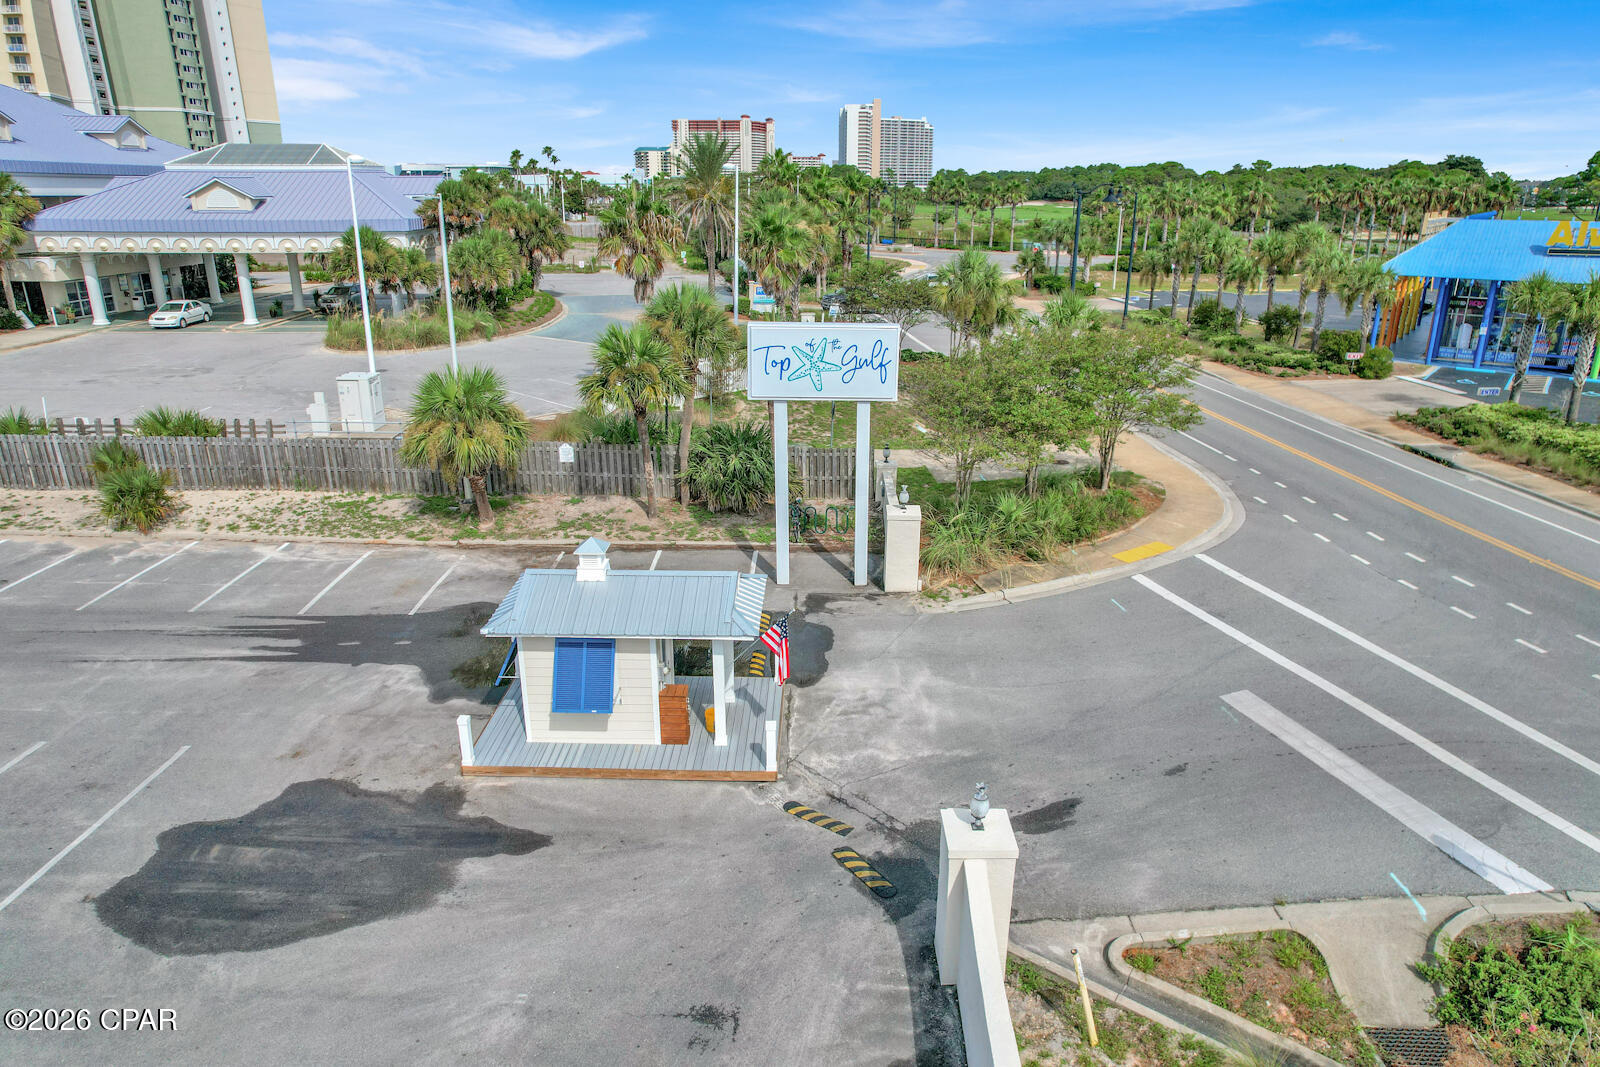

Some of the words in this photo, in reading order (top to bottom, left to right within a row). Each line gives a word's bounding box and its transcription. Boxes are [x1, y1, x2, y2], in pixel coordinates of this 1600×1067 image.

[753, 345, 791, 381] Top
[804, 337, 817, 353] of
[840, 339, 893, 384] Gulf
[1480, 388, 1500, 396] ENTER
